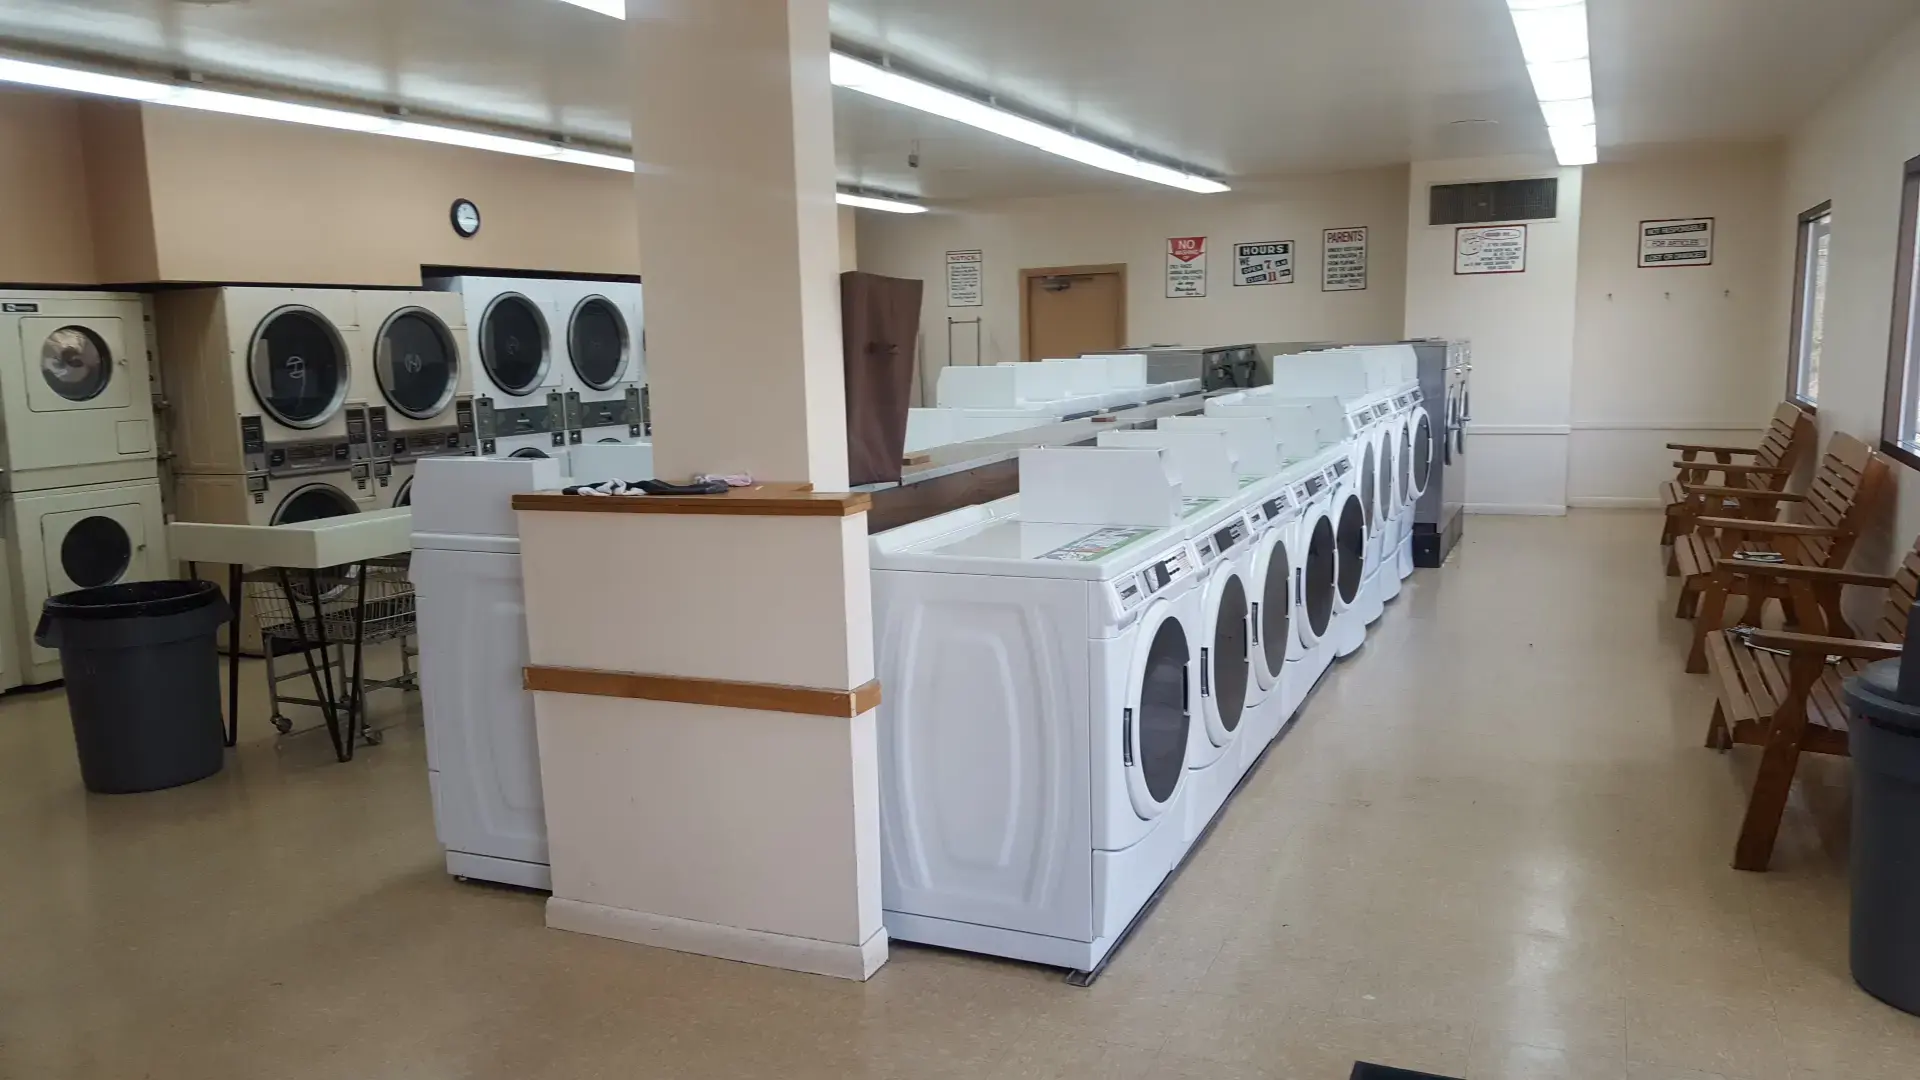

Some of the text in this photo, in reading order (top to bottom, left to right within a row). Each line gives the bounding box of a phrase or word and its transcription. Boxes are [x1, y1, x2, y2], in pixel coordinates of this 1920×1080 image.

[1661, 223, 1706, 234] RESPONSIBLE
[1327, 230, 1364, 243] PARENTS
[1178, 239, 1195, 250] NO
[1242, 245, 1284, 255] HOURS
[1238, 257, 1250, 266] WE
[1646, 254, 1662, 262] LOST
[1243, 265, 1262, 274] OPEN
[1263, 260, 1272, 269] 7
